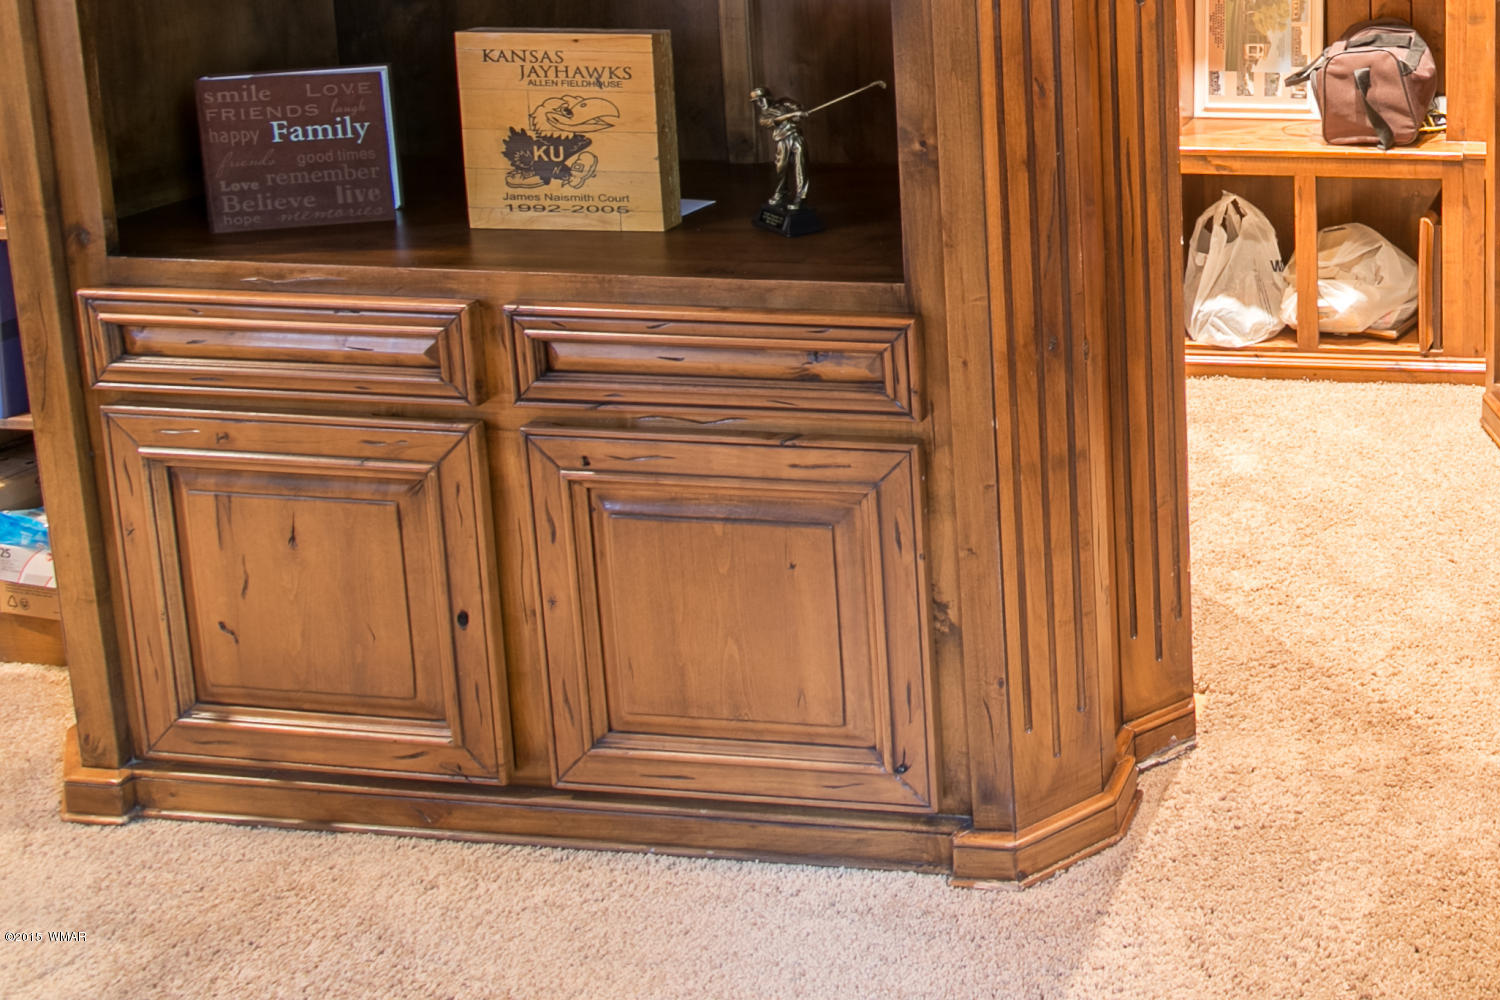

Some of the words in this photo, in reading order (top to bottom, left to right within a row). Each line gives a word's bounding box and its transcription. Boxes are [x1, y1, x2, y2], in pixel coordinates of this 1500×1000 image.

[481, 48, 564, 64] KANSAS
[519, 64, 633, 81] JAYHAWKS
[527, 78, 558, 88] ALLEN
[560, 78, 623, 89] FIELDHOUSE
[203, 84, 272, 104] smile
[305, 82, 373, 97] LOVE
[205, 103, 320, 122] FRIENDS
[208, 127, 260, 147] happy
[269, 115, 371, 144] Family
[296, 149, 334, 167] good
[336, 148, 376, 162] times
[532, 145, 565, 162] KU
[219, 180, 261, 193] Love
[265, 163, 381, 187] remember
[221, 192, 317, 214] Believe
[335, 184, 382, 205] live
[502, 192, 541, 202] James
[543, 193, 594, 203] Naismith
[597, 193, 630, 203] Court
[222, 213, 263, 227] hope
